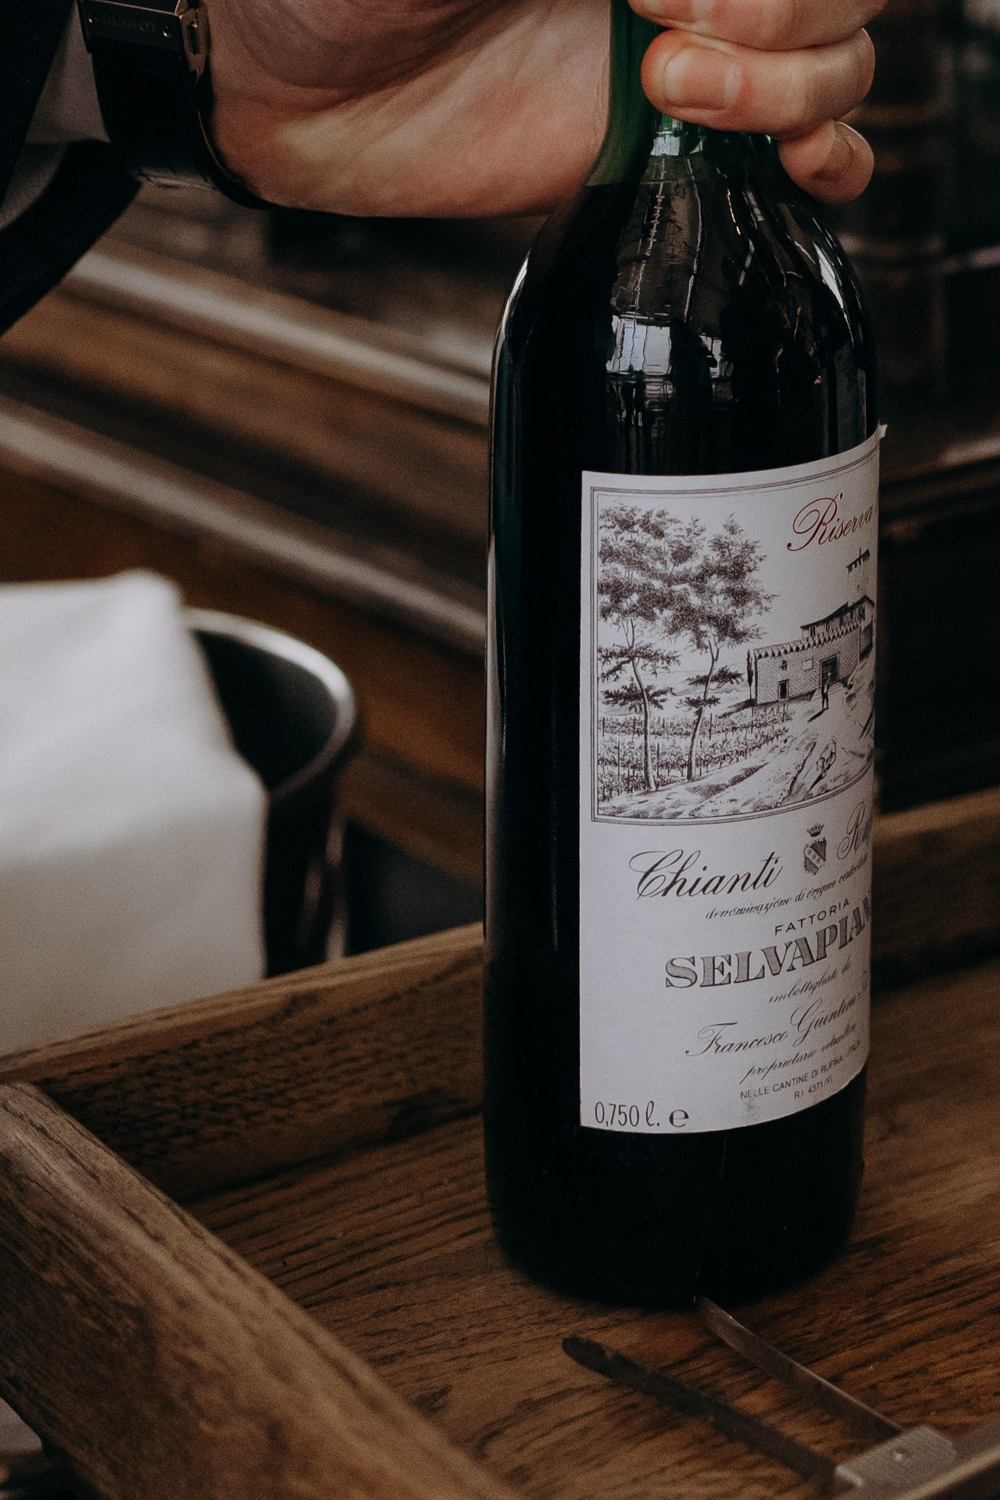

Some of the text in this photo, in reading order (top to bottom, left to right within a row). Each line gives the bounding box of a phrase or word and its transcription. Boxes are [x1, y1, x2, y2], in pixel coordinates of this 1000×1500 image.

[786, 492, 875, 552] Riserva
[628, 849, 784, 901] Chianti
[774, 898, 850, 937] FATTORIA
[685, 1021, 788, 1057] Francesco
[739, 1085, 770, 1100] NELLE
[772, 1073, 809, 1093] CANTINE
[594, 1100, 640, 1128] 0,750
